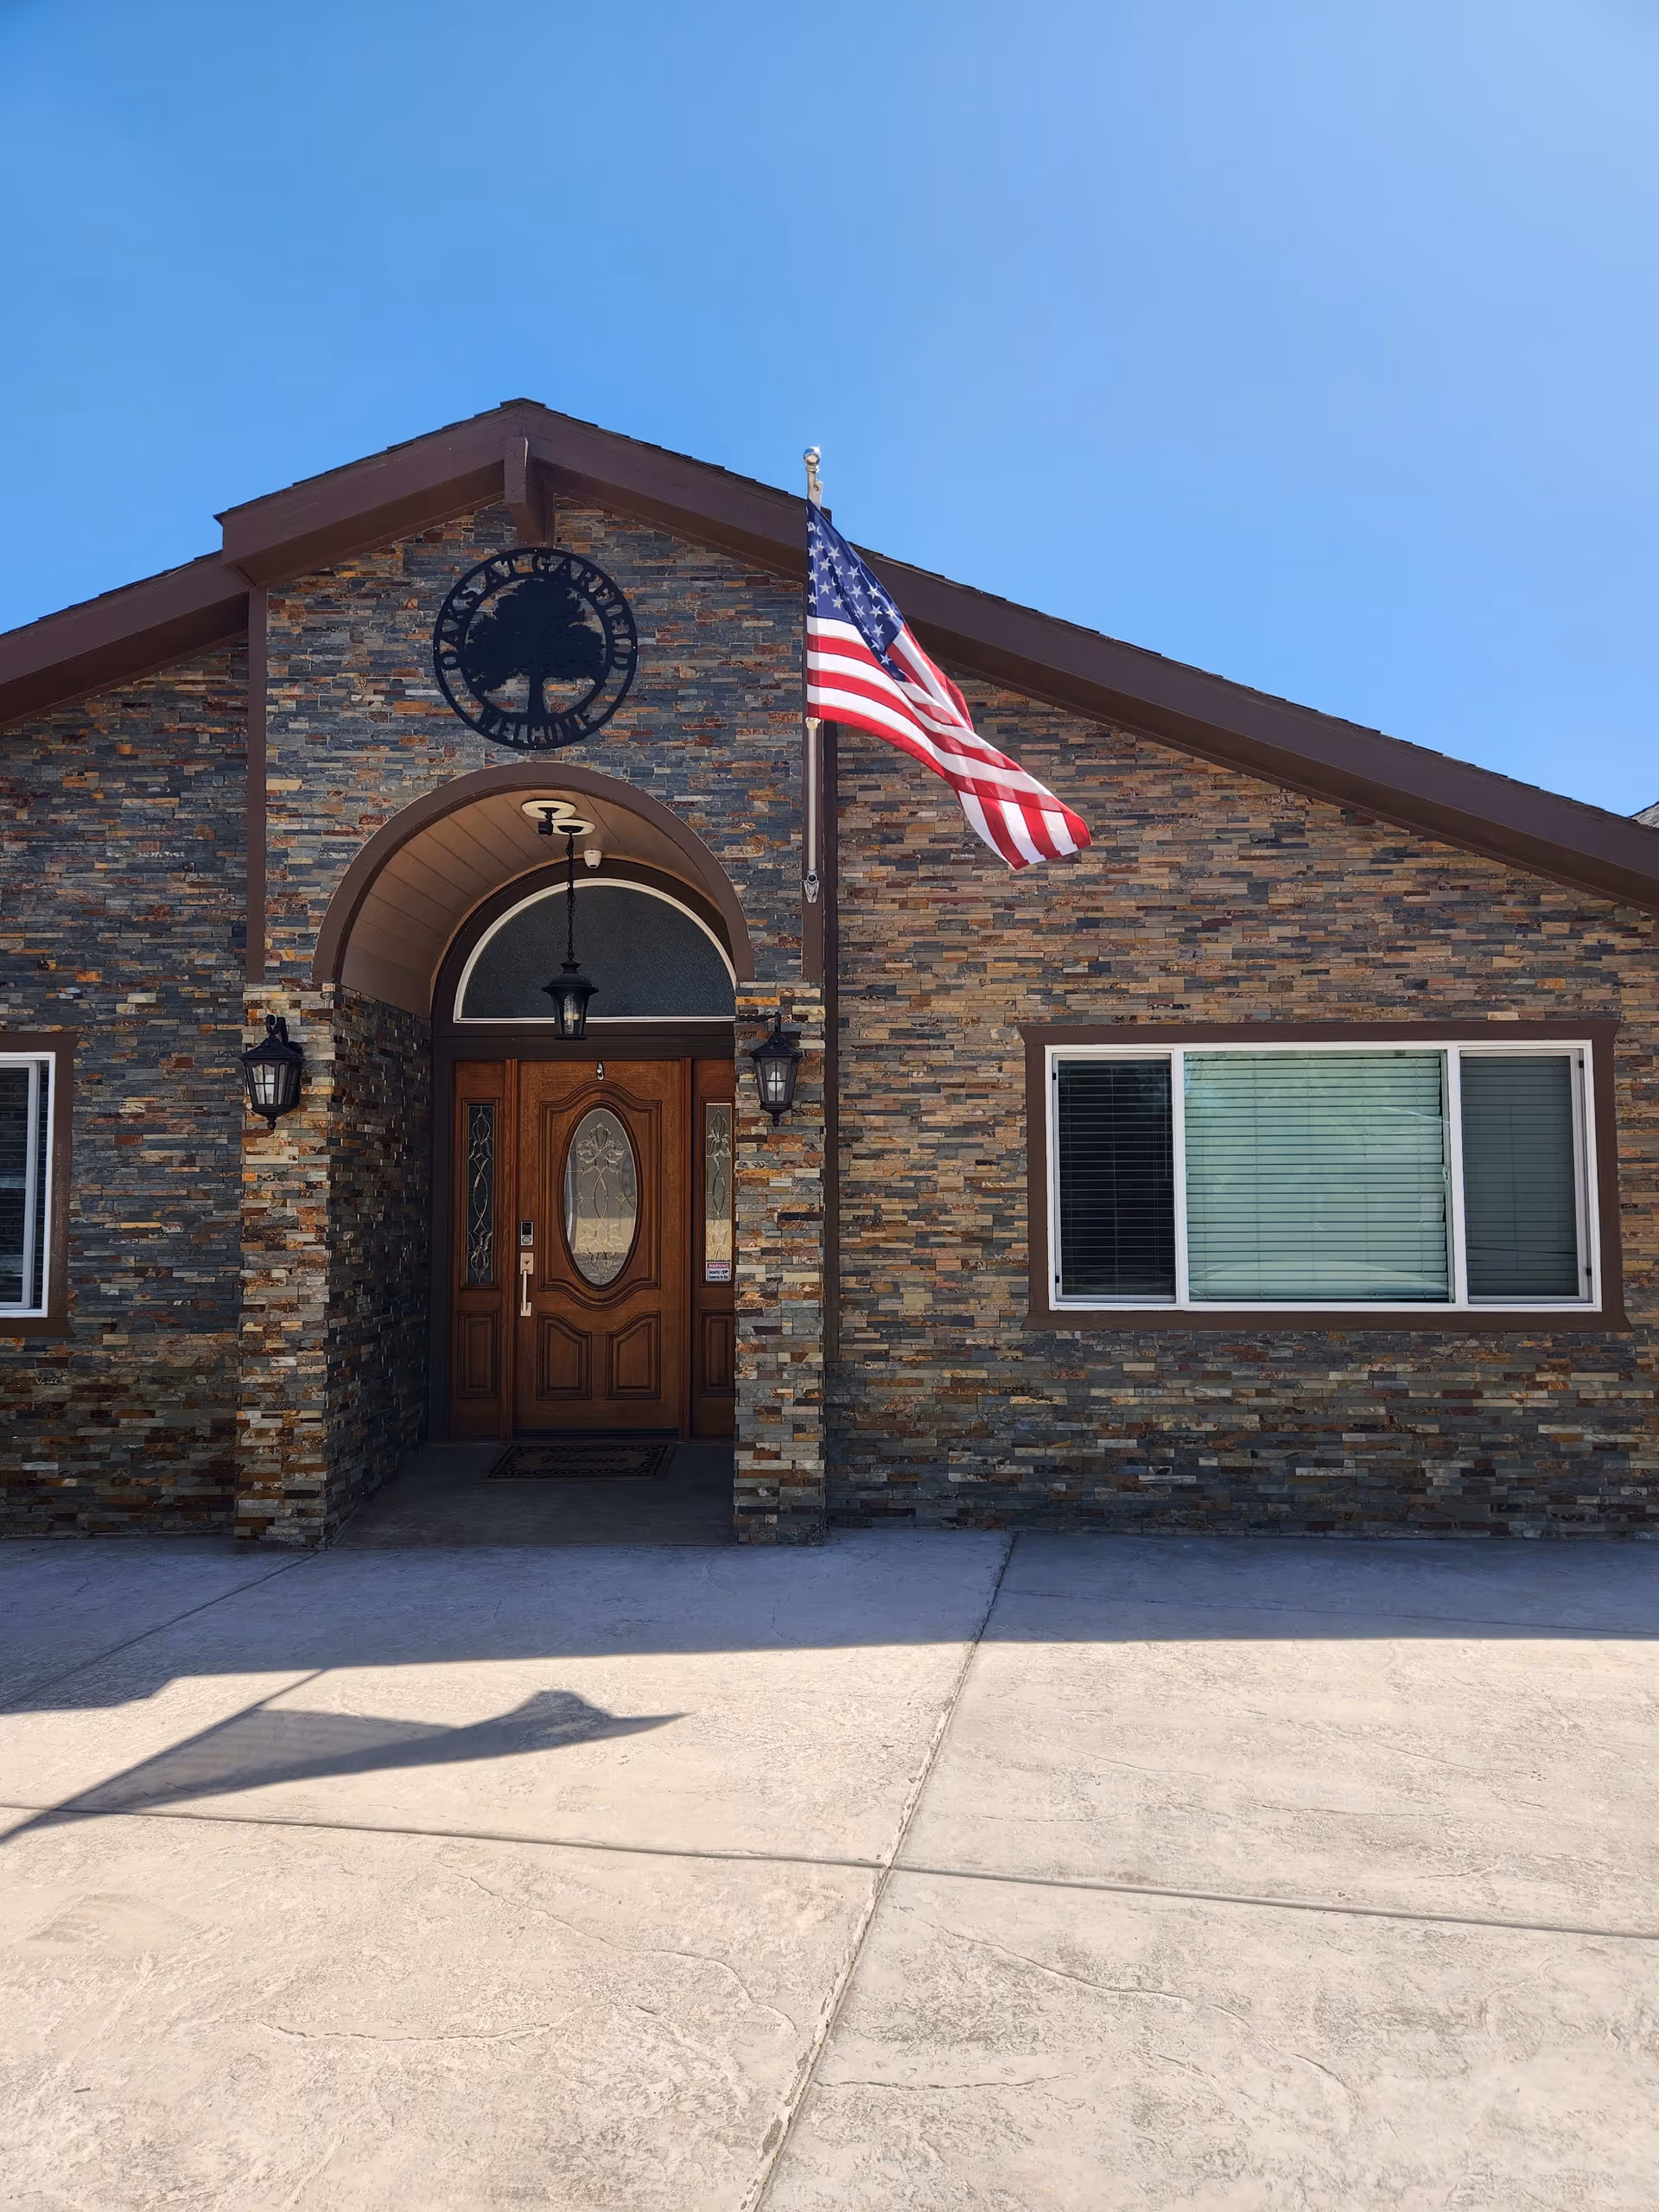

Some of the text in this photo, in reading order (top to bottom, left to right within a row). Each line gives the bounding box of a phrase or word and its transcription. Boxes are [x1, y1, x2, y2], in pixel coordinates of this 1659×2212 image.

[440, 552, 632, 671] OAKS AT GARFIELD
[478, 707, 593, 746] WELCOME
